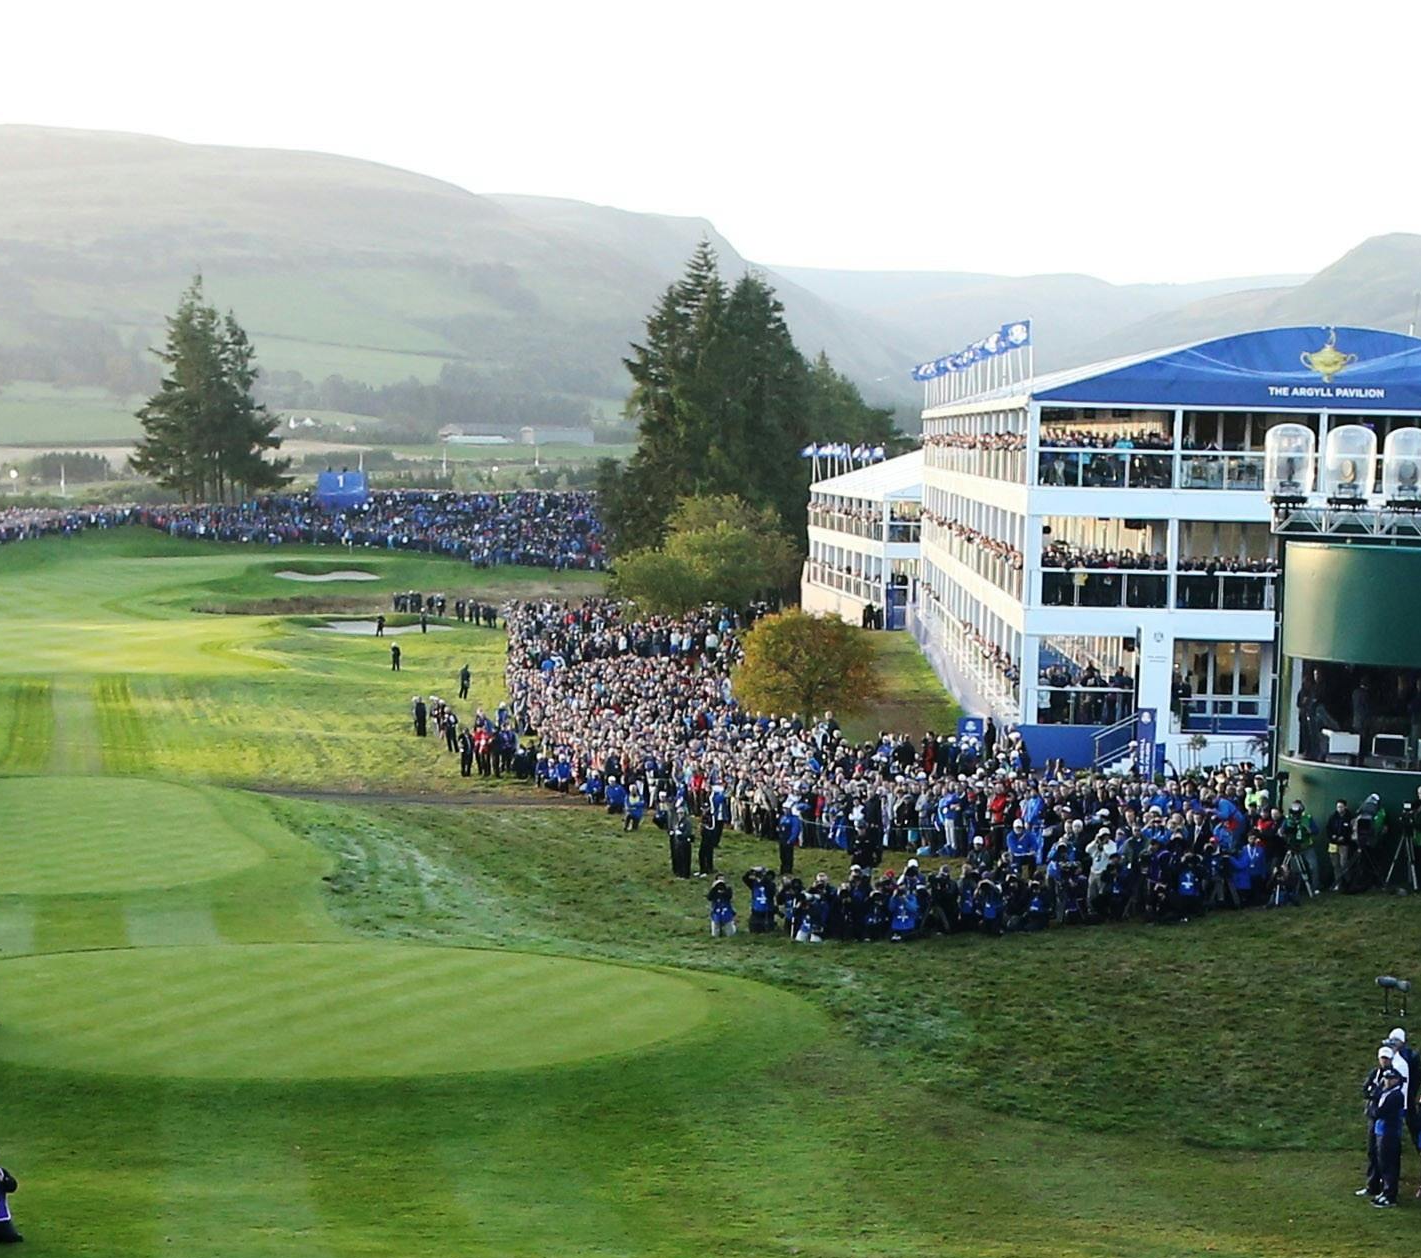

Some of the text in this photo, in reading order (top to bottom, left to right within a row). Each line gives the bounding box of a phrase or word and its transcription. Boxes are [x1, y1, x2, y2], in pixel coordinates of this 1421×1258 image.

[1268, 386, 1385, 399] THE ARGYLL PAVILION
[337, 475, 344, 488] 1
